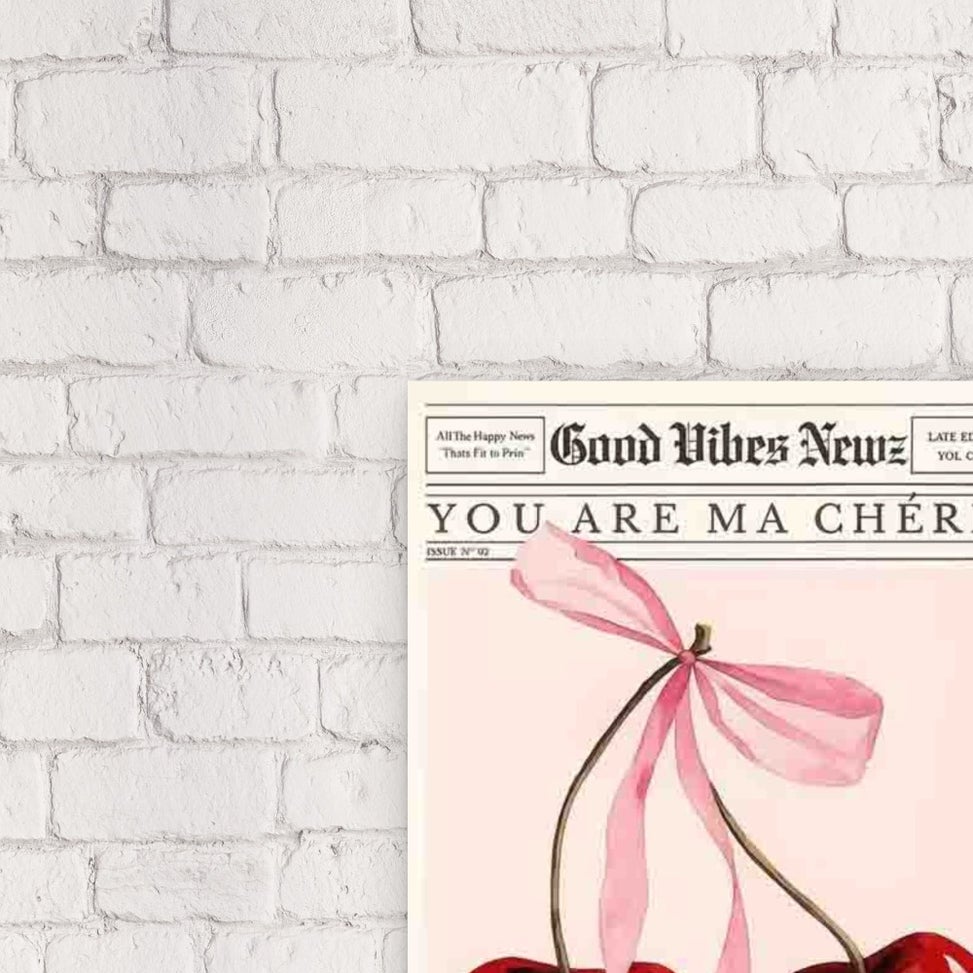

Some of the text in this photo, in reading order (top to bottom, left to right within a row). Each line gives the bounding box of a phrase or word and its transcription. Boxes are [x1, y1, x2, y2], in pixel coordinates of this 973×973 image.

[437, 430, 536, 444] All The Happy News
[928, 431, 957, 442] LATE
[550, 421, 908, 467] Good Vibes Newz
[473, 447, 487, 458] Fit
[490, 447, 499, 458] to
[427, 503, 544, 534] YOU
[572, 502, 680, 534] ARE
[708, 502, 789, 534] MA
[426, 546, 457, 557] ISSUE
